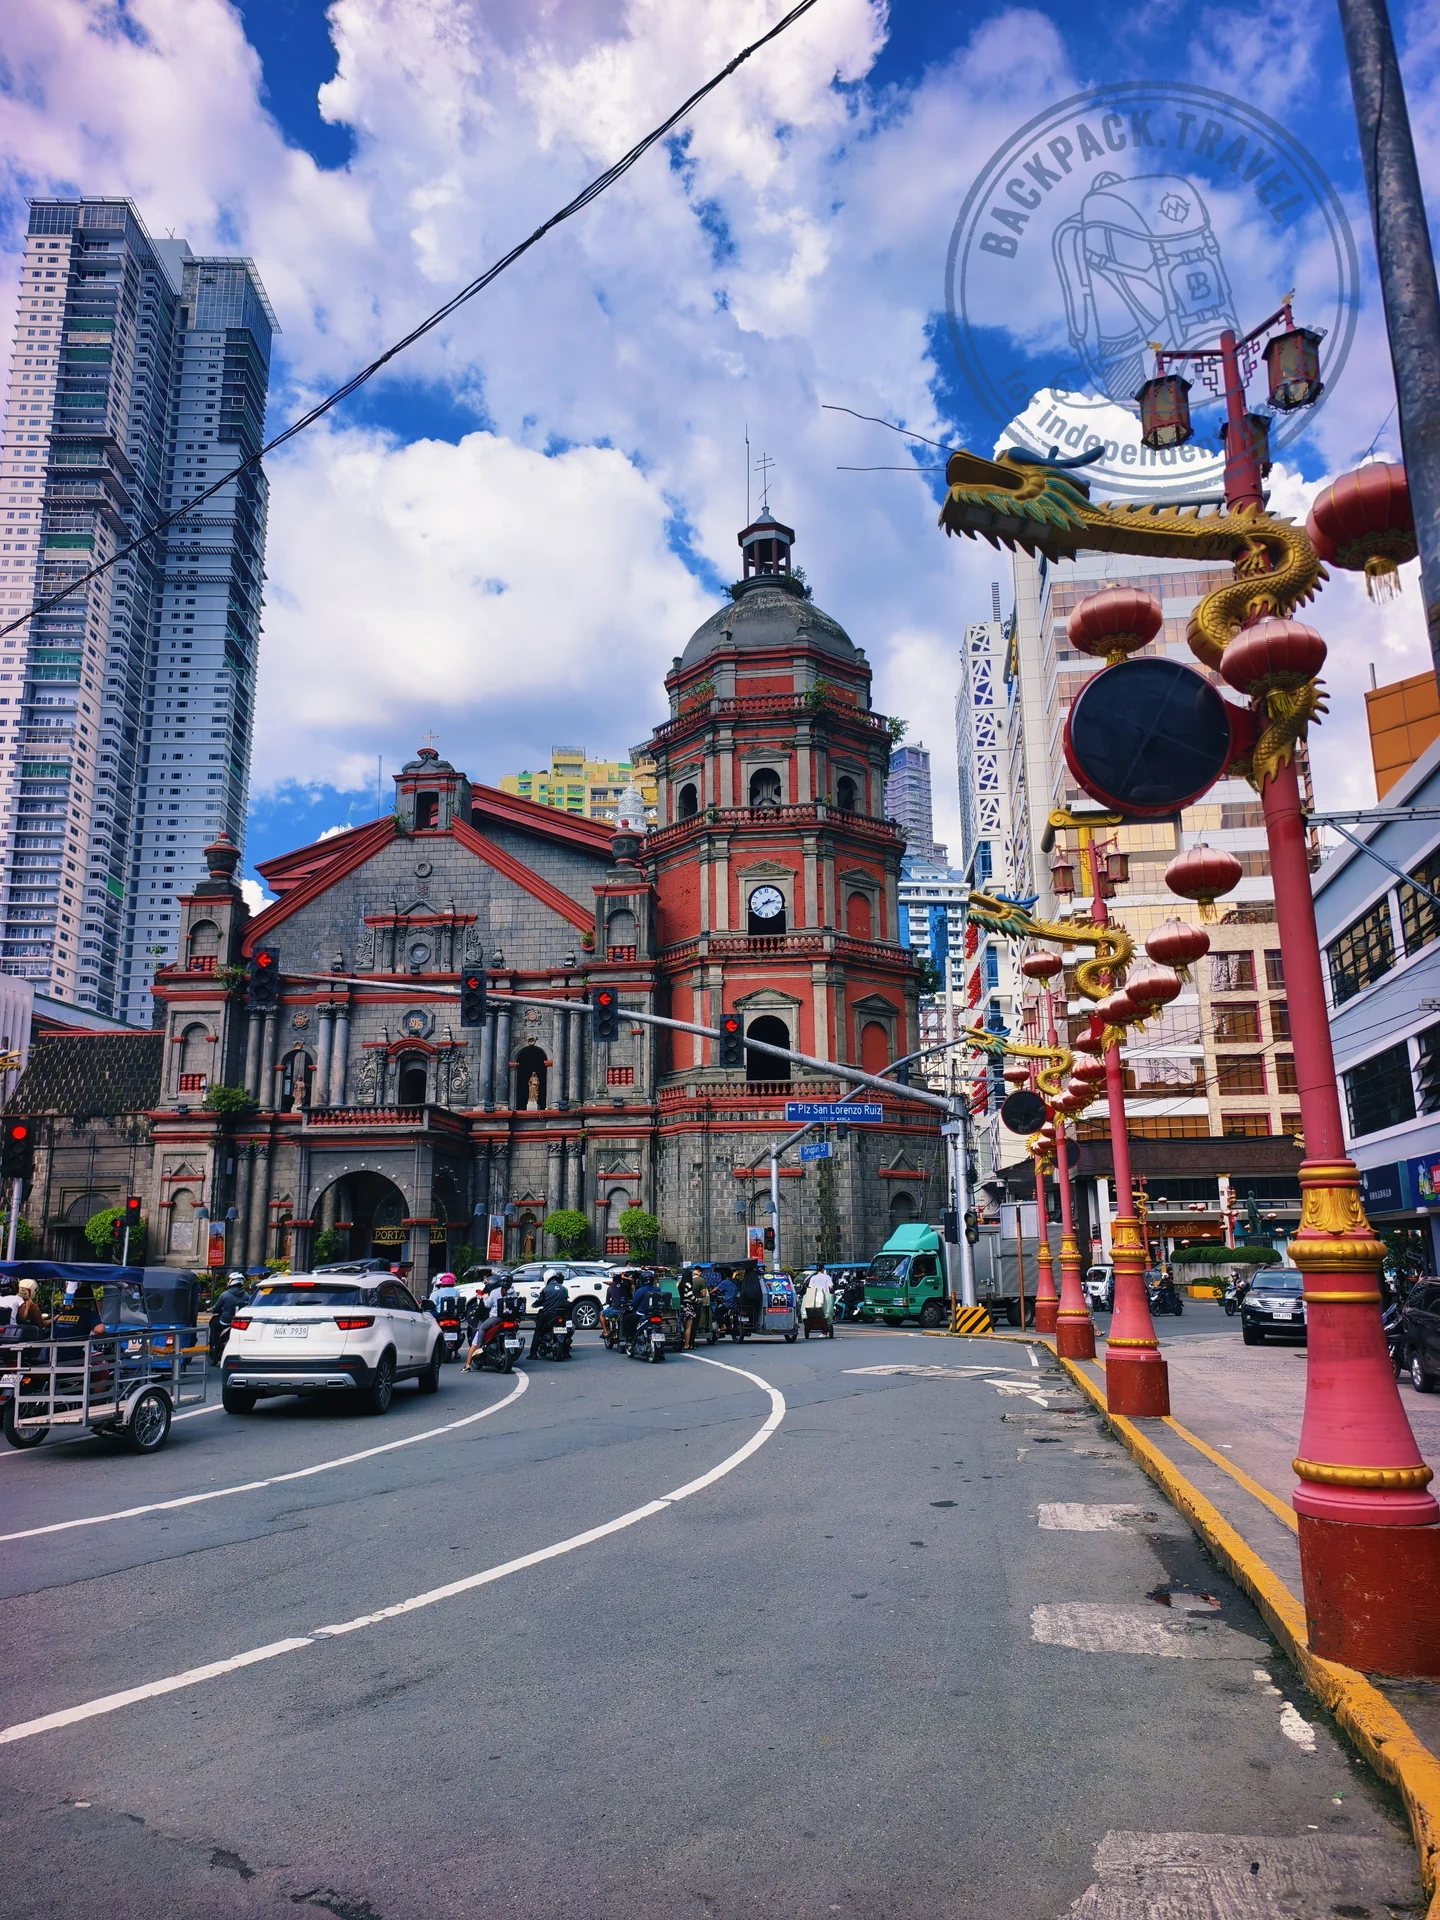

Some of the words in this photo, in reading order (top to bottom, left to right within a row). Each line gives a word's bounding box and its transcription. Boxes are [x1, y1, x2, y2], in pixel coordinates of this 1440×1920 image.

[798, 1104, 811, 1114] Plz
[813, 1104, 828, 1115] San
[830, 1104, 862, 1115] Lorenzo
[864, 1105, 881, 1115] Ruiz
[820, 1144, 826, 1152] St
[375, 1230, 407, 1240] PORTA
